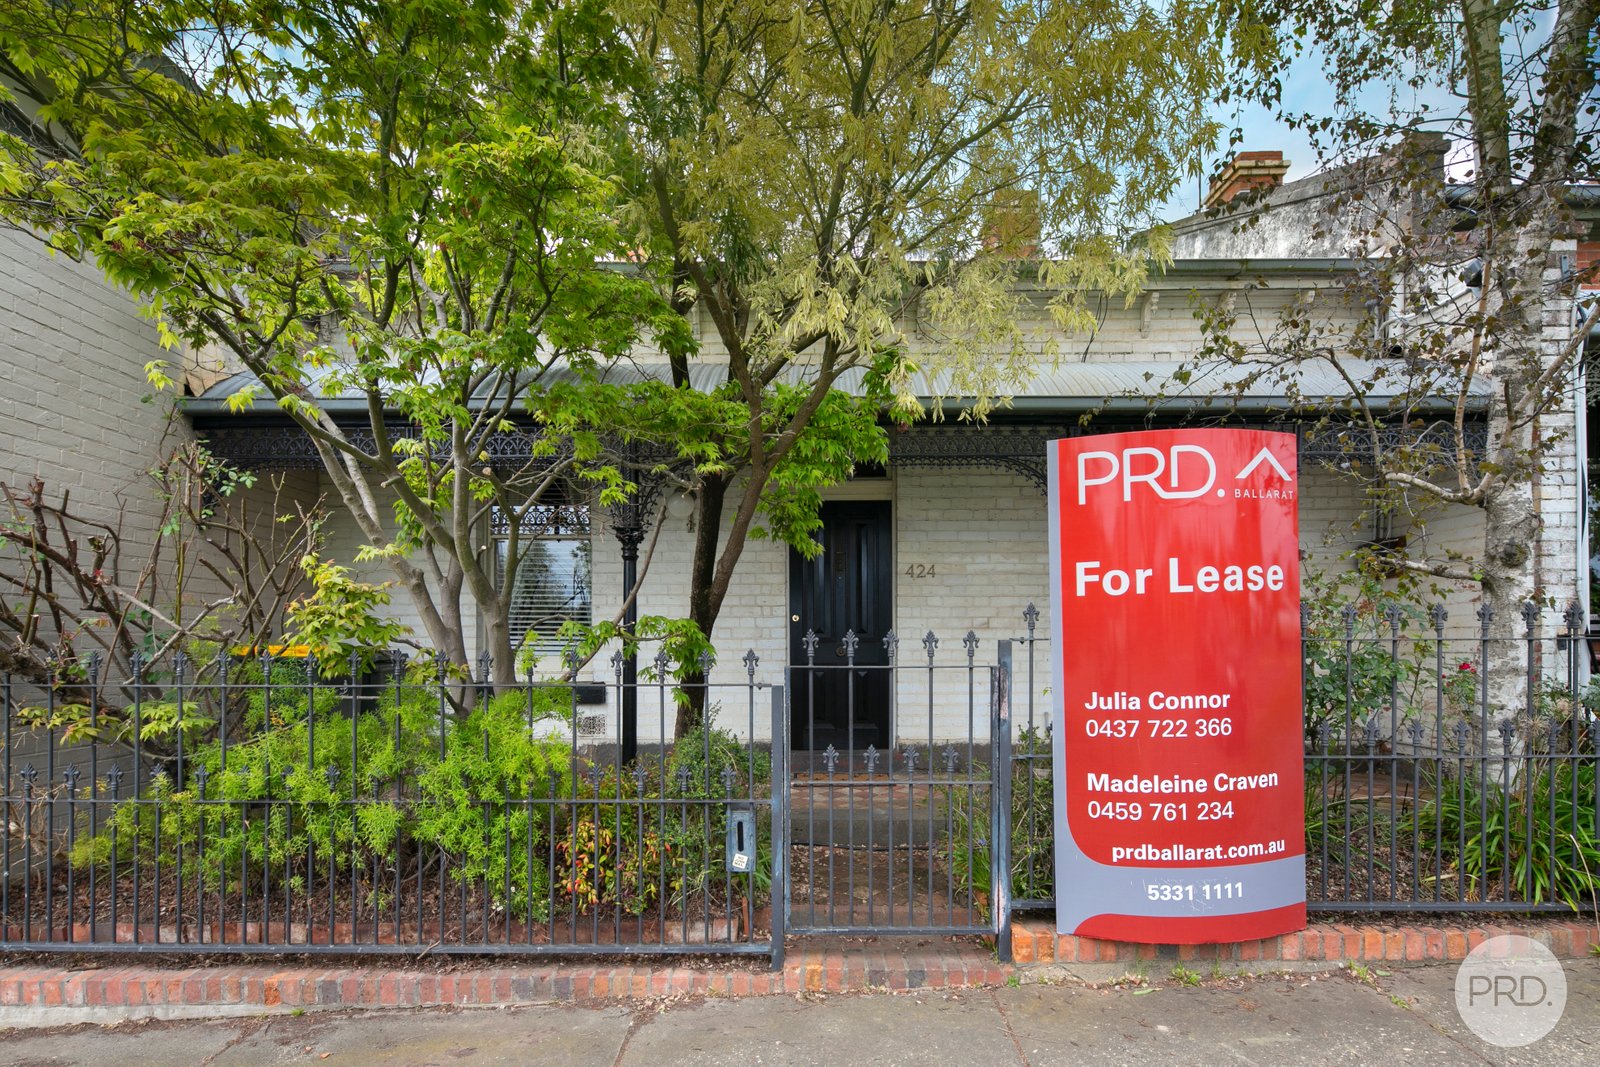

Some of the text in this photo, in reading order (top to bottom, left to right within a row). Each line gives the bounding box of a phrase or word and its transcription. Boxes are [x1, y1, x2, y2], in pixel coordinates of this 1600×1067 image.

[1234, 488, 1294, 500] BALLARAT
[904, 563, 936, 578] 424
[1075, 557, 1284, 597] For Lease
[1084, 691, 1230, 710] Julia Connor
[1085, 718, 1232, 738] 0437 722 366
[1087, 772, 1279, 794] Madeleine Craven
[1087, 800, 1234, 821] 0459 761 234
[1112, 839, 1285, 862] prdballarat.com.au
[1147, 882, 1243, 901] 5331 1111
